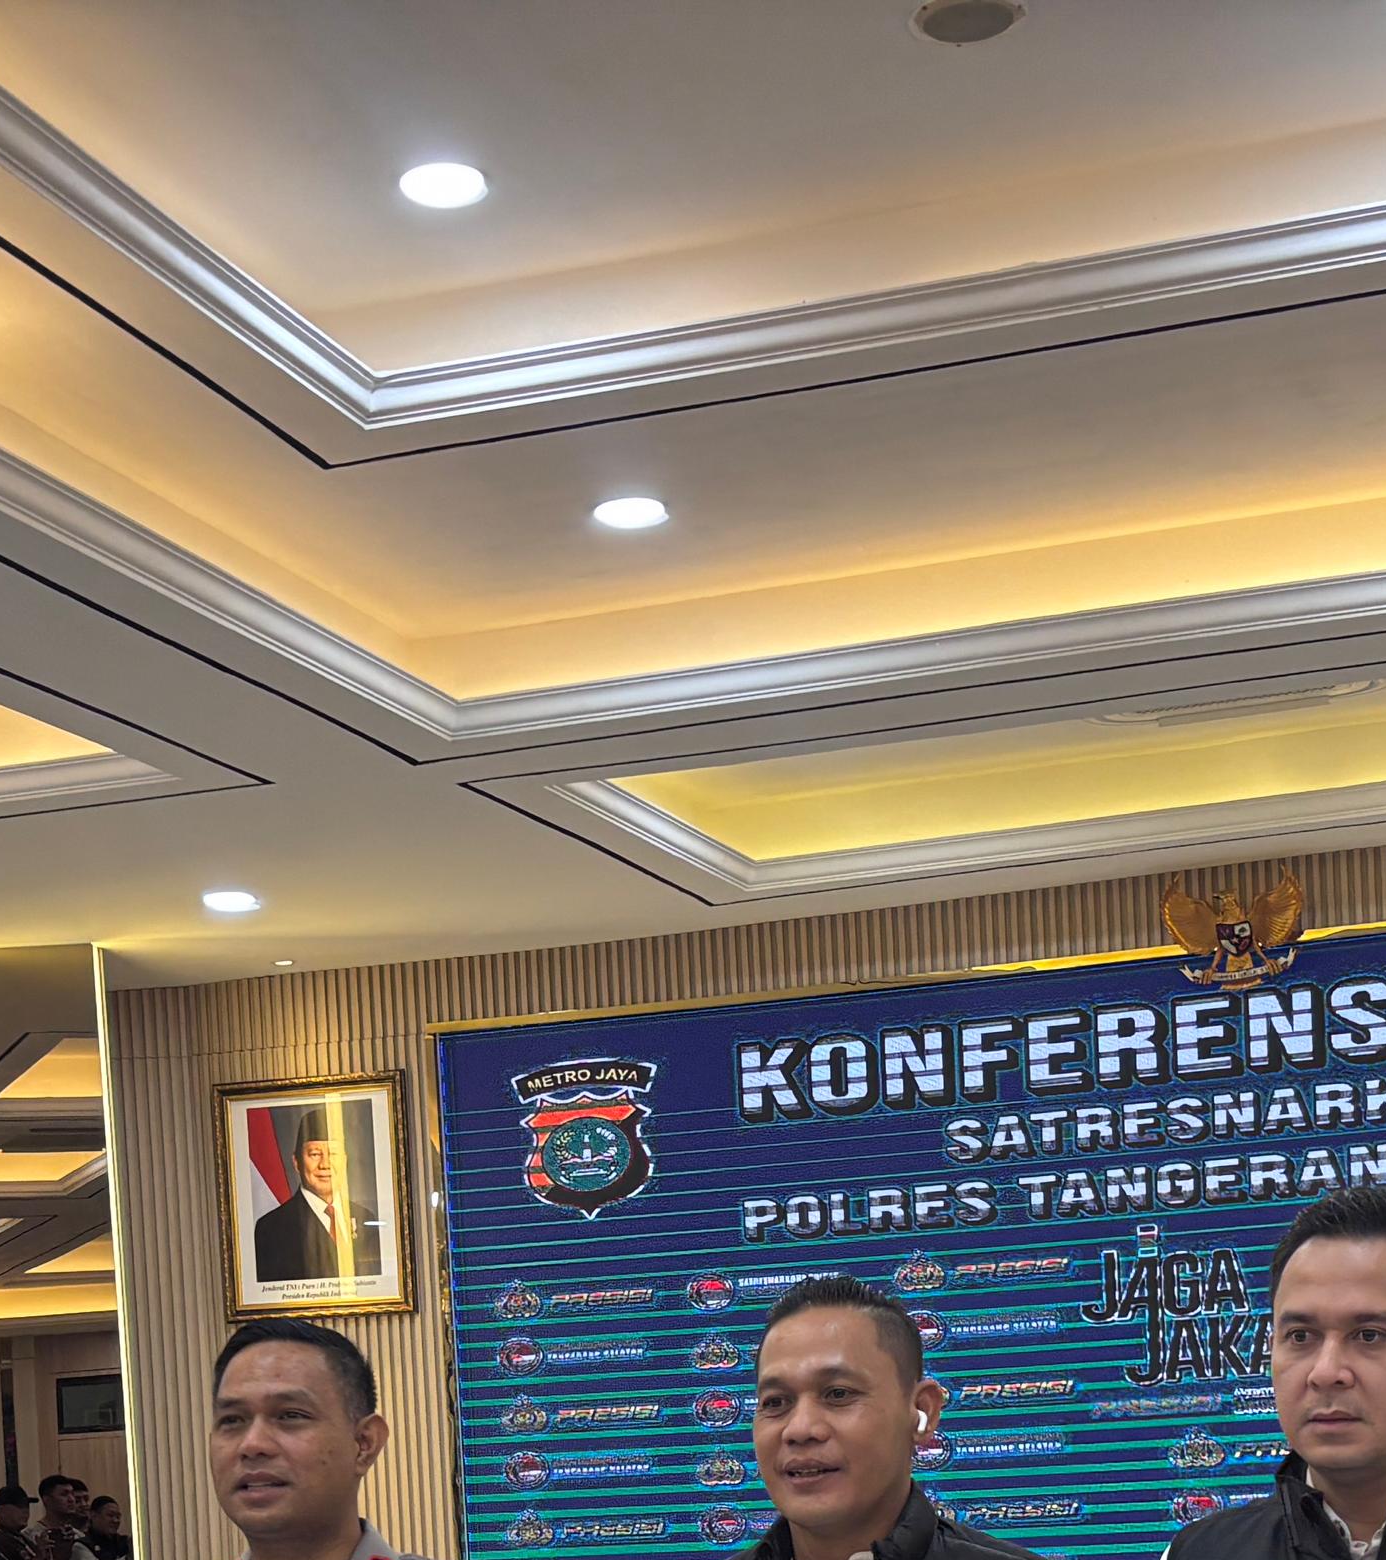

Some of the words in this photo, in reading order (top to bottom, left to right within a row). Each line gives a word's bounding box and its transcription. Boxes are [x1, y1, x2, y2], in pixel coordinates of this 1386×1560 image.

[527, 1069, 591, 1093] METRO
[595, 1068, 638, 1082] JAYA
[743, 1180, 997, 1244] POLRES
[1081, 1247, 1250, 1323] JAGA
